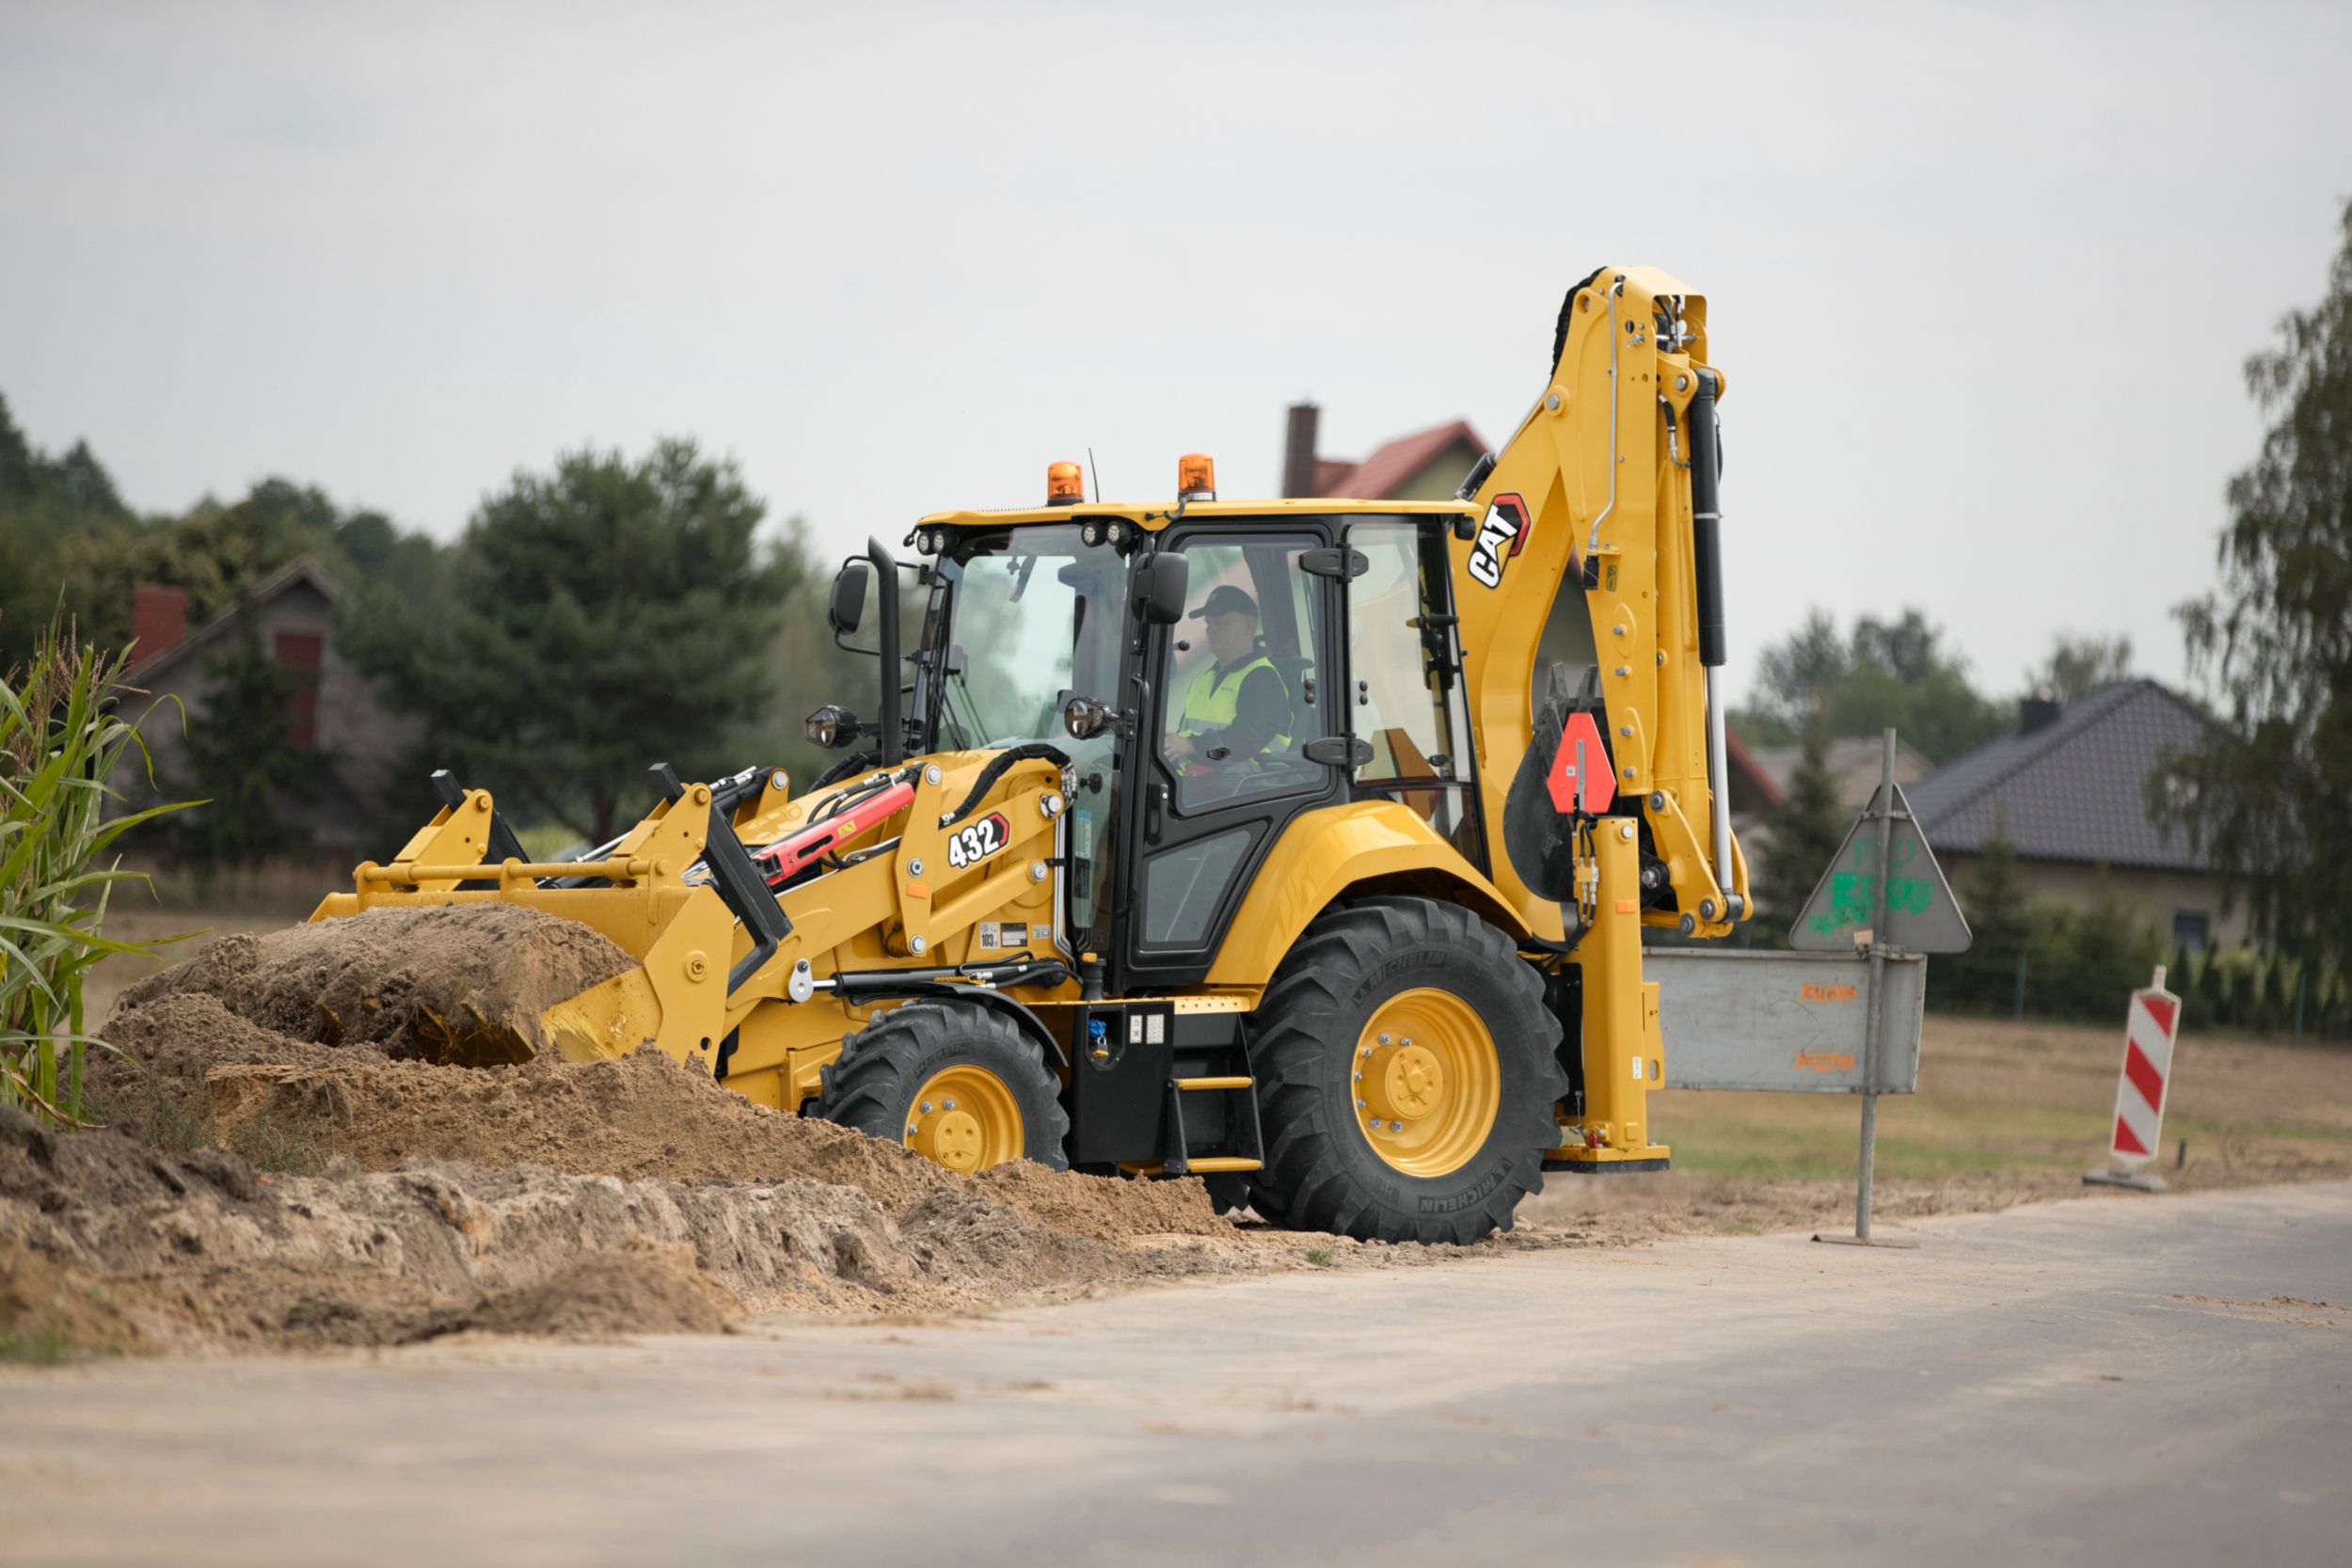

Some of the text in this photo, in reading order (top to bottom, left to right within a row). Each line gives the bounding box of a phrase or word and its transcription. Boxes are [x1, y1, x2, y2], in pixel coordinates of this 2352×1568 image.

[1470, 505, 1518, 586] CAT
[949, 819, 1000, 866] 432
[981, 933, 993, 947] 103
[1370, 951, 1446, 989] MICHELIN
[1421, 1174, 1497, 1212] MICHELIN
